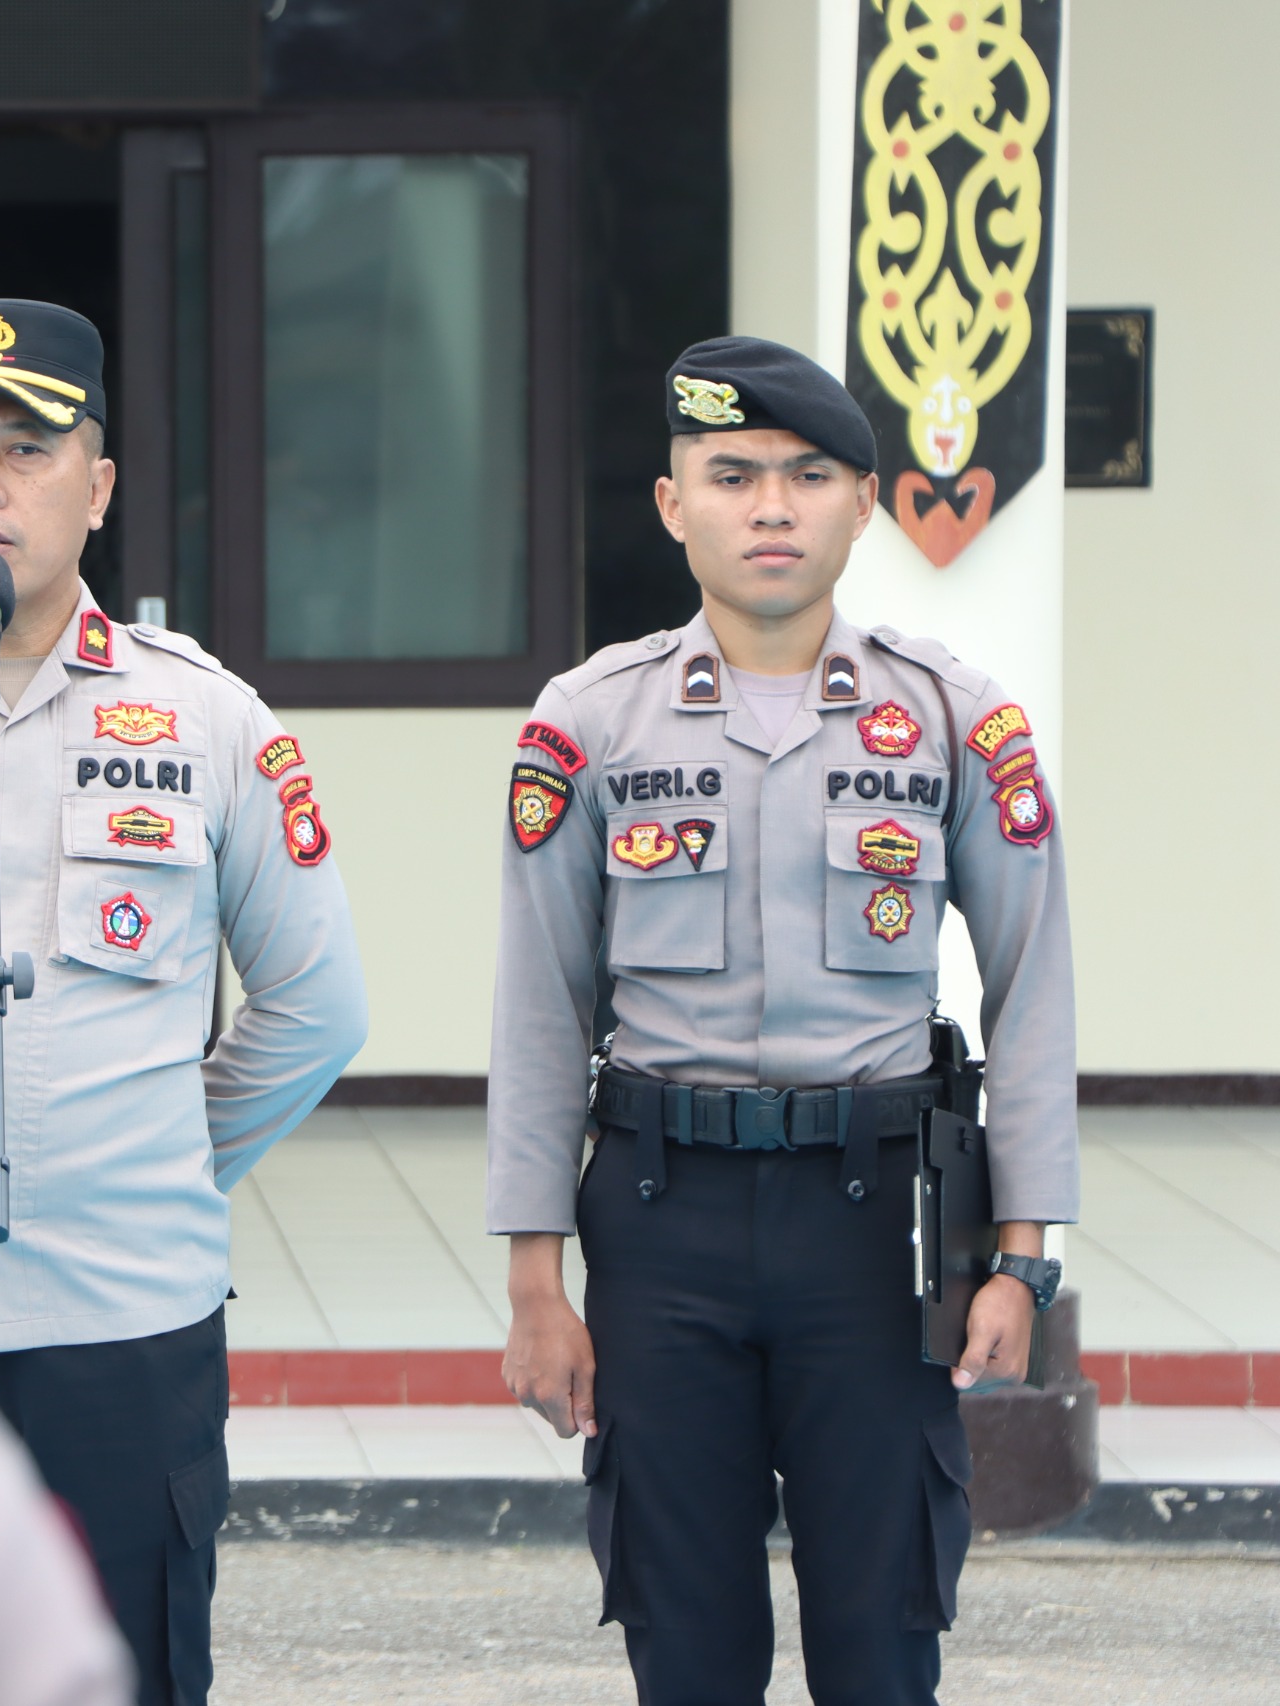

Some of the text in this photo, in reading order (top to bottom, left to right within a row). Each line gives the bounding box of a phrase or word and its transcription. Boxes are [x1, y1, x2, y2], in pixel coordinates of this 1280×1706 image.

[537, 727, 579, 767] SAMAPTA
[77, 757, 191, 794] POLRI
[607, 767, 721, 805] VERI.G
[828, 769, 942, 808] POLRI
